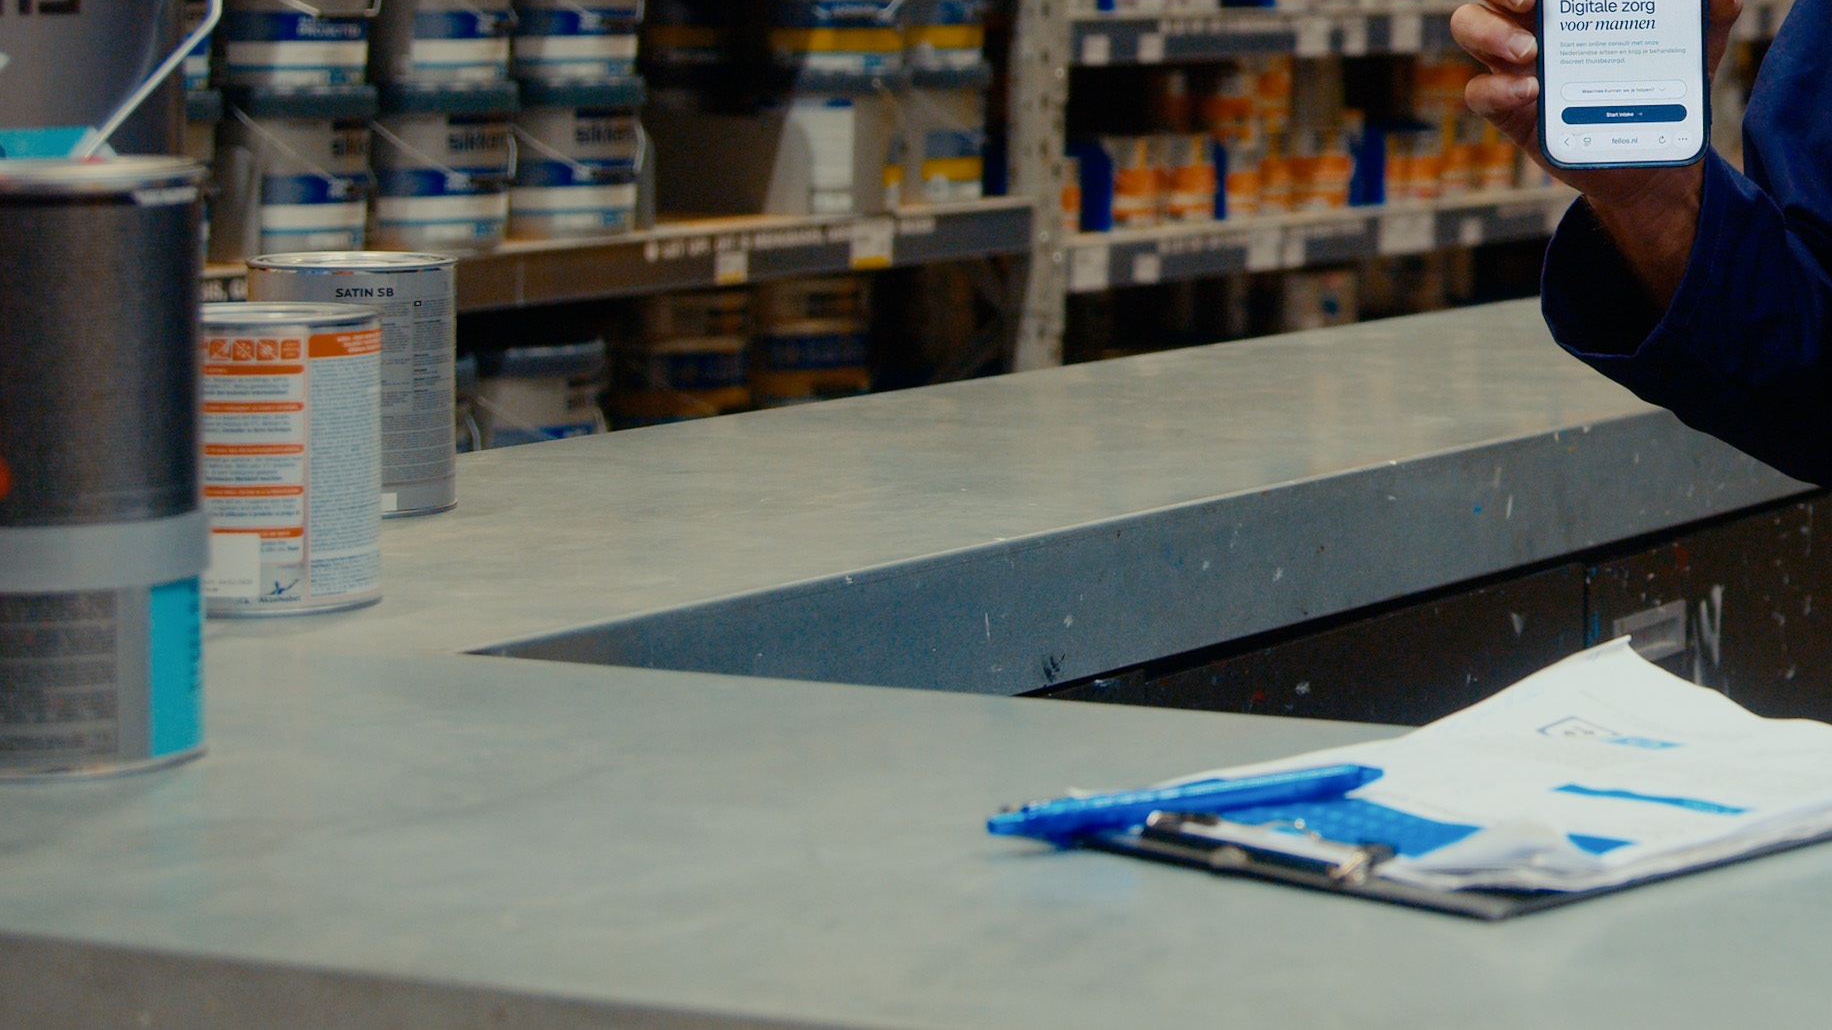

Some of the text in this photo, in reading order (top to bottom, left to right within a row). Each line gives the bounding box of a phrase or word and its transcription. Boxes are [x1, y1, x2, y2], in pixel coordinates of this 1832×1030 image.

[1560, 0, 1656, 16] Digitale zorg
[1560, 19, 1656, 32] voor mannen
[1649, 47, 1687, 55] behandeling
[1612, 137, 1638, 145] fellos.nl
[336, 287, 395, 298] SATIN SB
